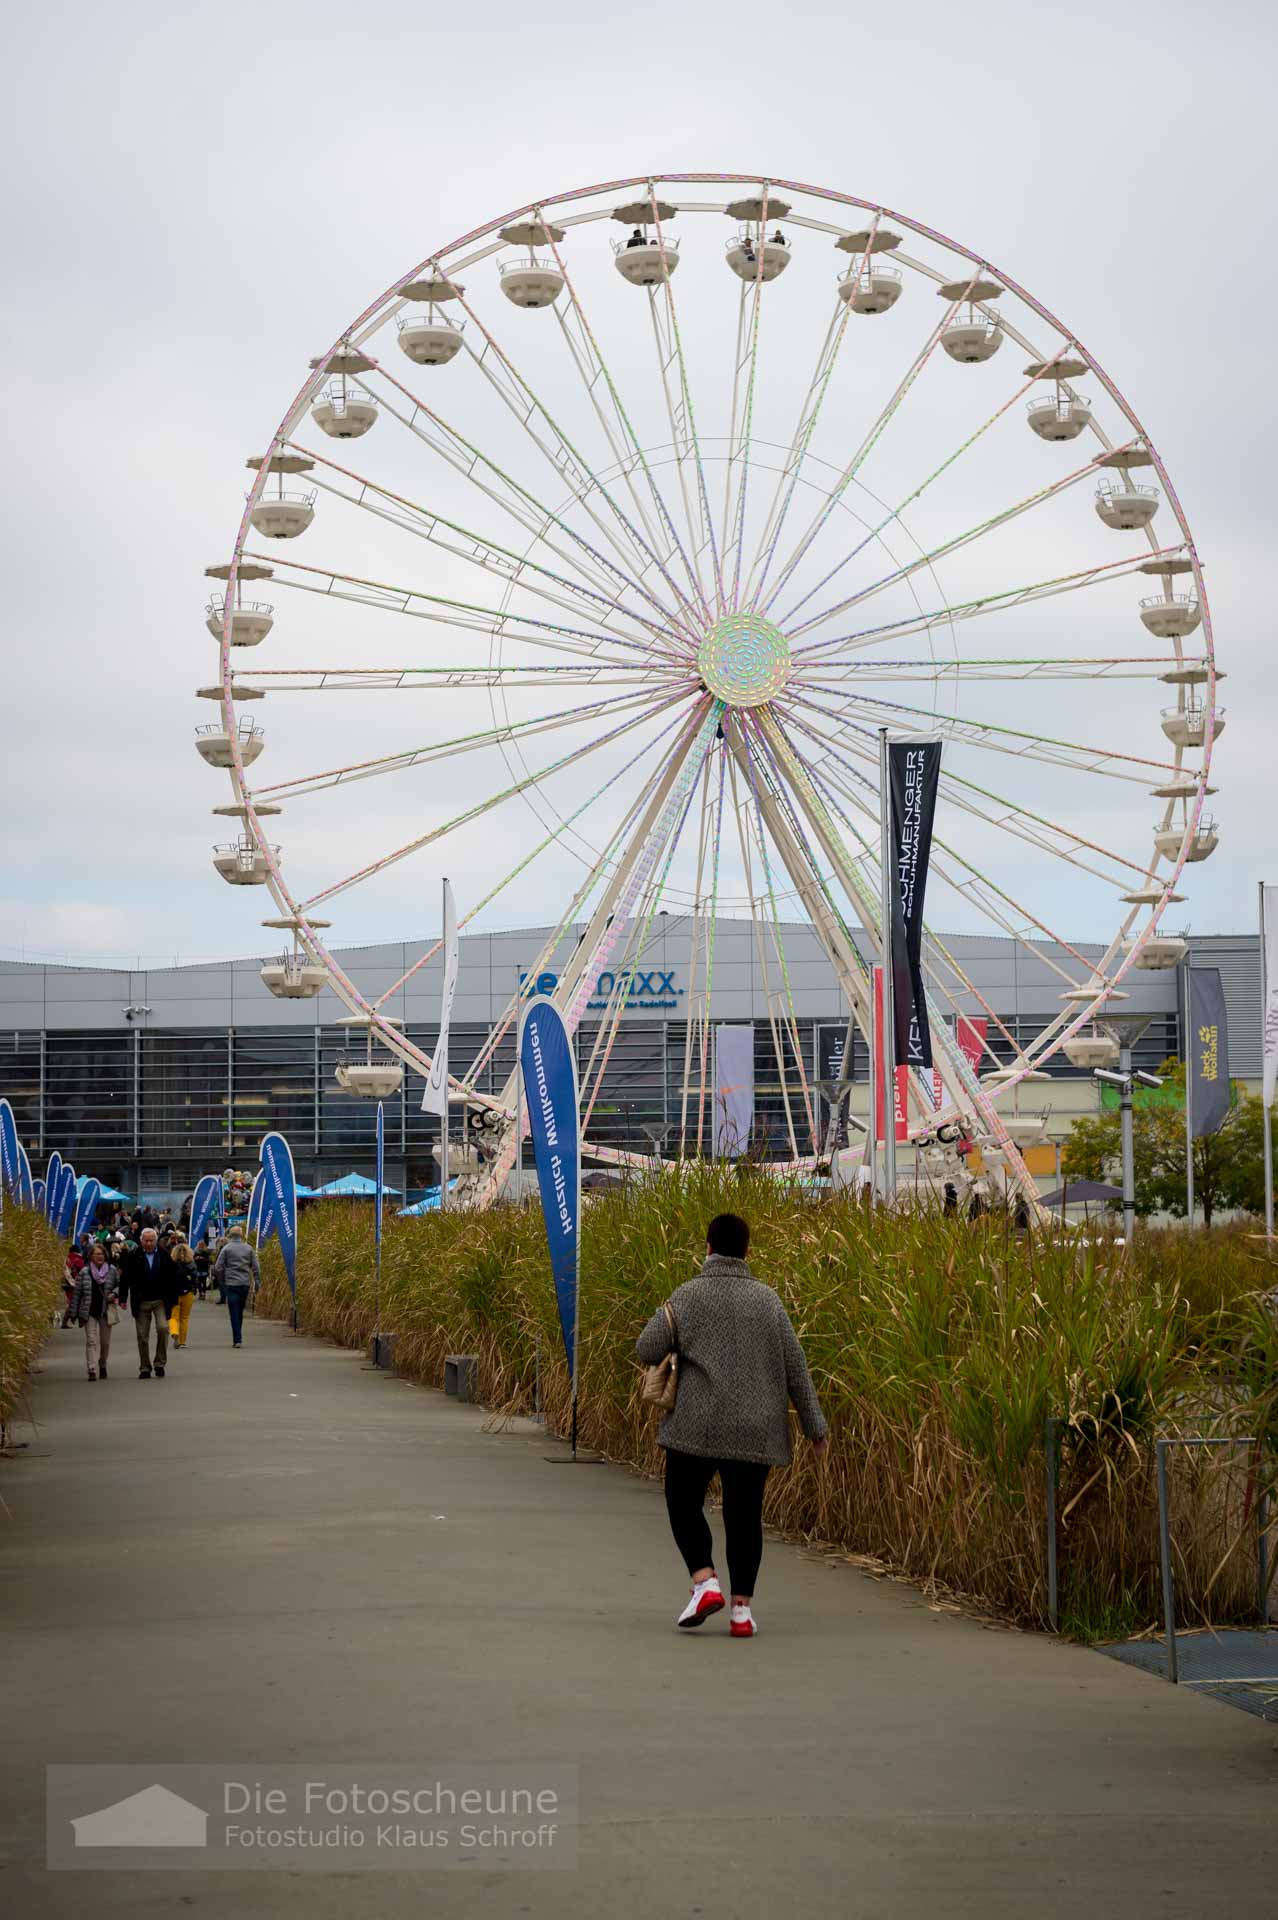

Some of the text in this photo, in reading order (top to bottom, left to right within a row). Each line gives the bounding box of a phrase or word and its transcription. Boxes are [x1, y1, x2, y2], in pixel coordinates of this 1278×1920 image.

[907, 750, 925, 918] SCHUHMANUFAKTUR
[1200, 1049, 1210, 1080] Jack
[1209, 1025, 1218, 1081] Wolfskin
